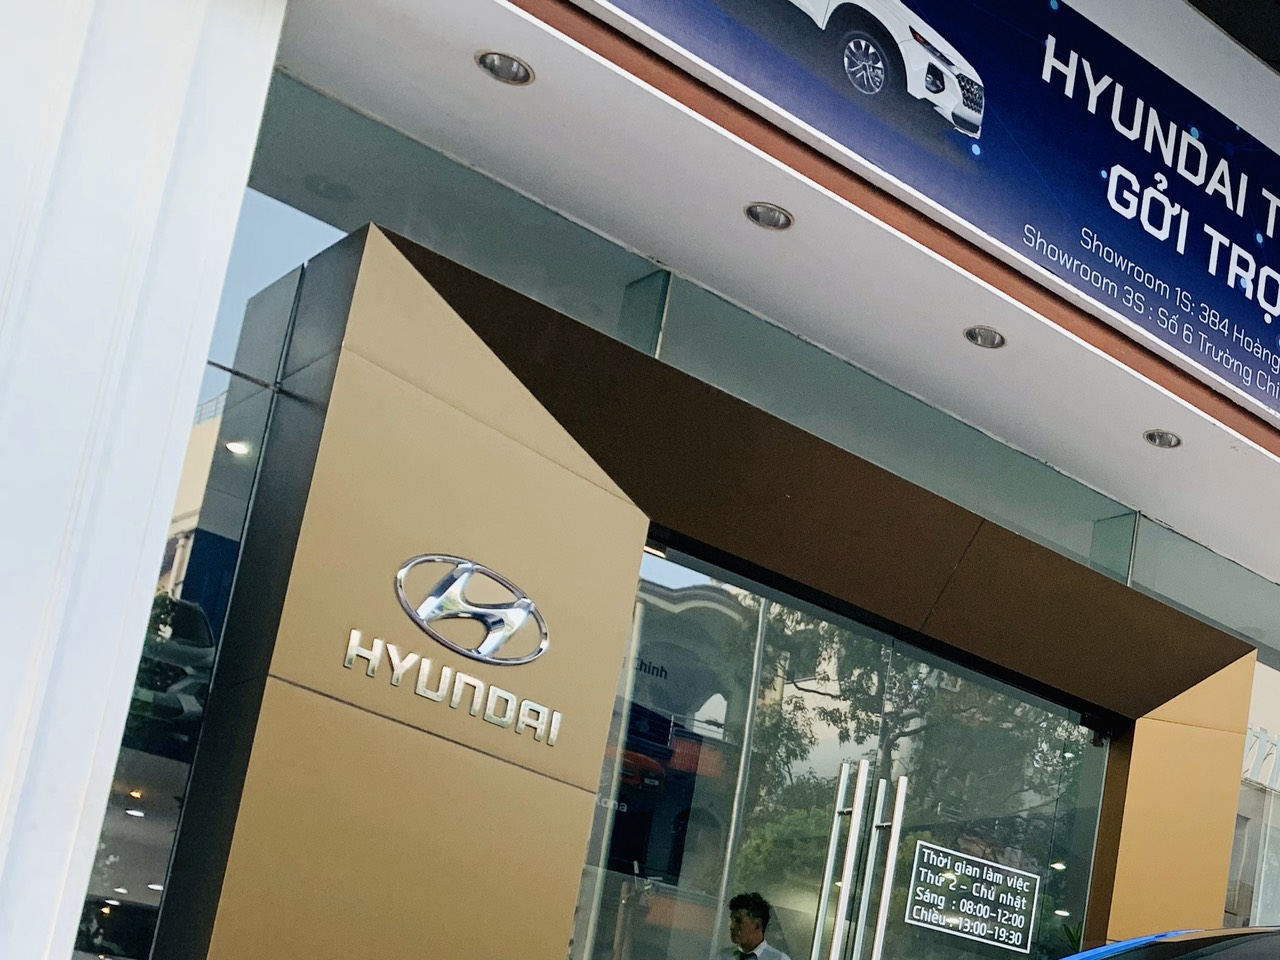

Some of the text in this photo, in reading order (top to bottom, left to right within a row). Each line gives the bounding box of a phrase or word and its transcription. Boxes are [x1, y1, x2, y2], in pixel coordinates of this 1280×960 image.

[1042, 34, 1249, 218] HYUNDAI
[1107, 164, 1190, 255] GỞI
[1022, 224, 1118, 298] Showroom
[1157, 307, 1179, 335] Số
[1182, 323, 1193, 344] 6
[1198, 331, 1253, 386] Trường
[1080, 227, 1170, 300] Showroom
[1198, 302, 1229, 337] 384
[1232, 324, 1280, 374] Hoàng
[343, 628, 563, 746] HYUNDAI
[912, 905, 946, 926] Chiều
[915, 886, 945, 909] Sáng
[919, 867, 945, 887] Thứ
[949, 875, 957, 890] 2
[972, 882, 995, 901] Chủ
[999, 892, 1028, 911] nhật
[922, 848, 1030, 893] Thời gian làm việc
